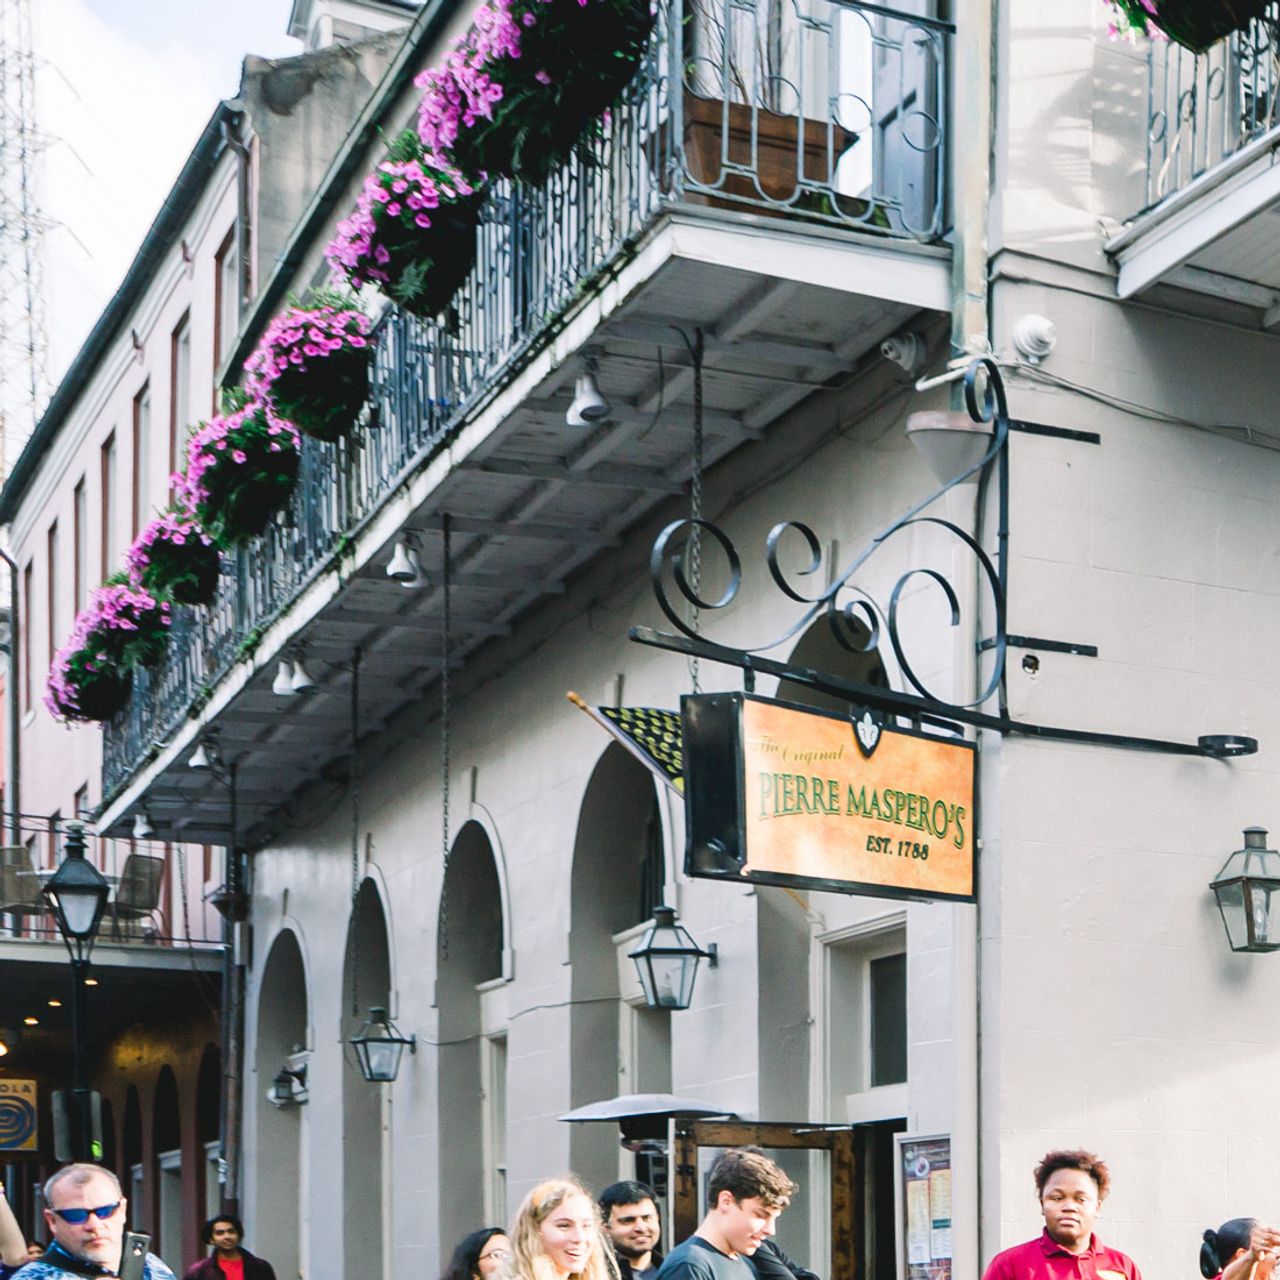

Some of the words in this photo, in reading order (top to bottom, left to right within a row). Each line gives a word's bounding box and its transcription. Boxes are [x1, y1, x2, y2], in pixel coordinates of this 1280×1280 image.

[759, 772, 841, 820] PIERRE
[846, 783, 966, 850] MASPERO'S
[865, 835, 893, 855] EST.
[897, 840, 930, 860] 1788
